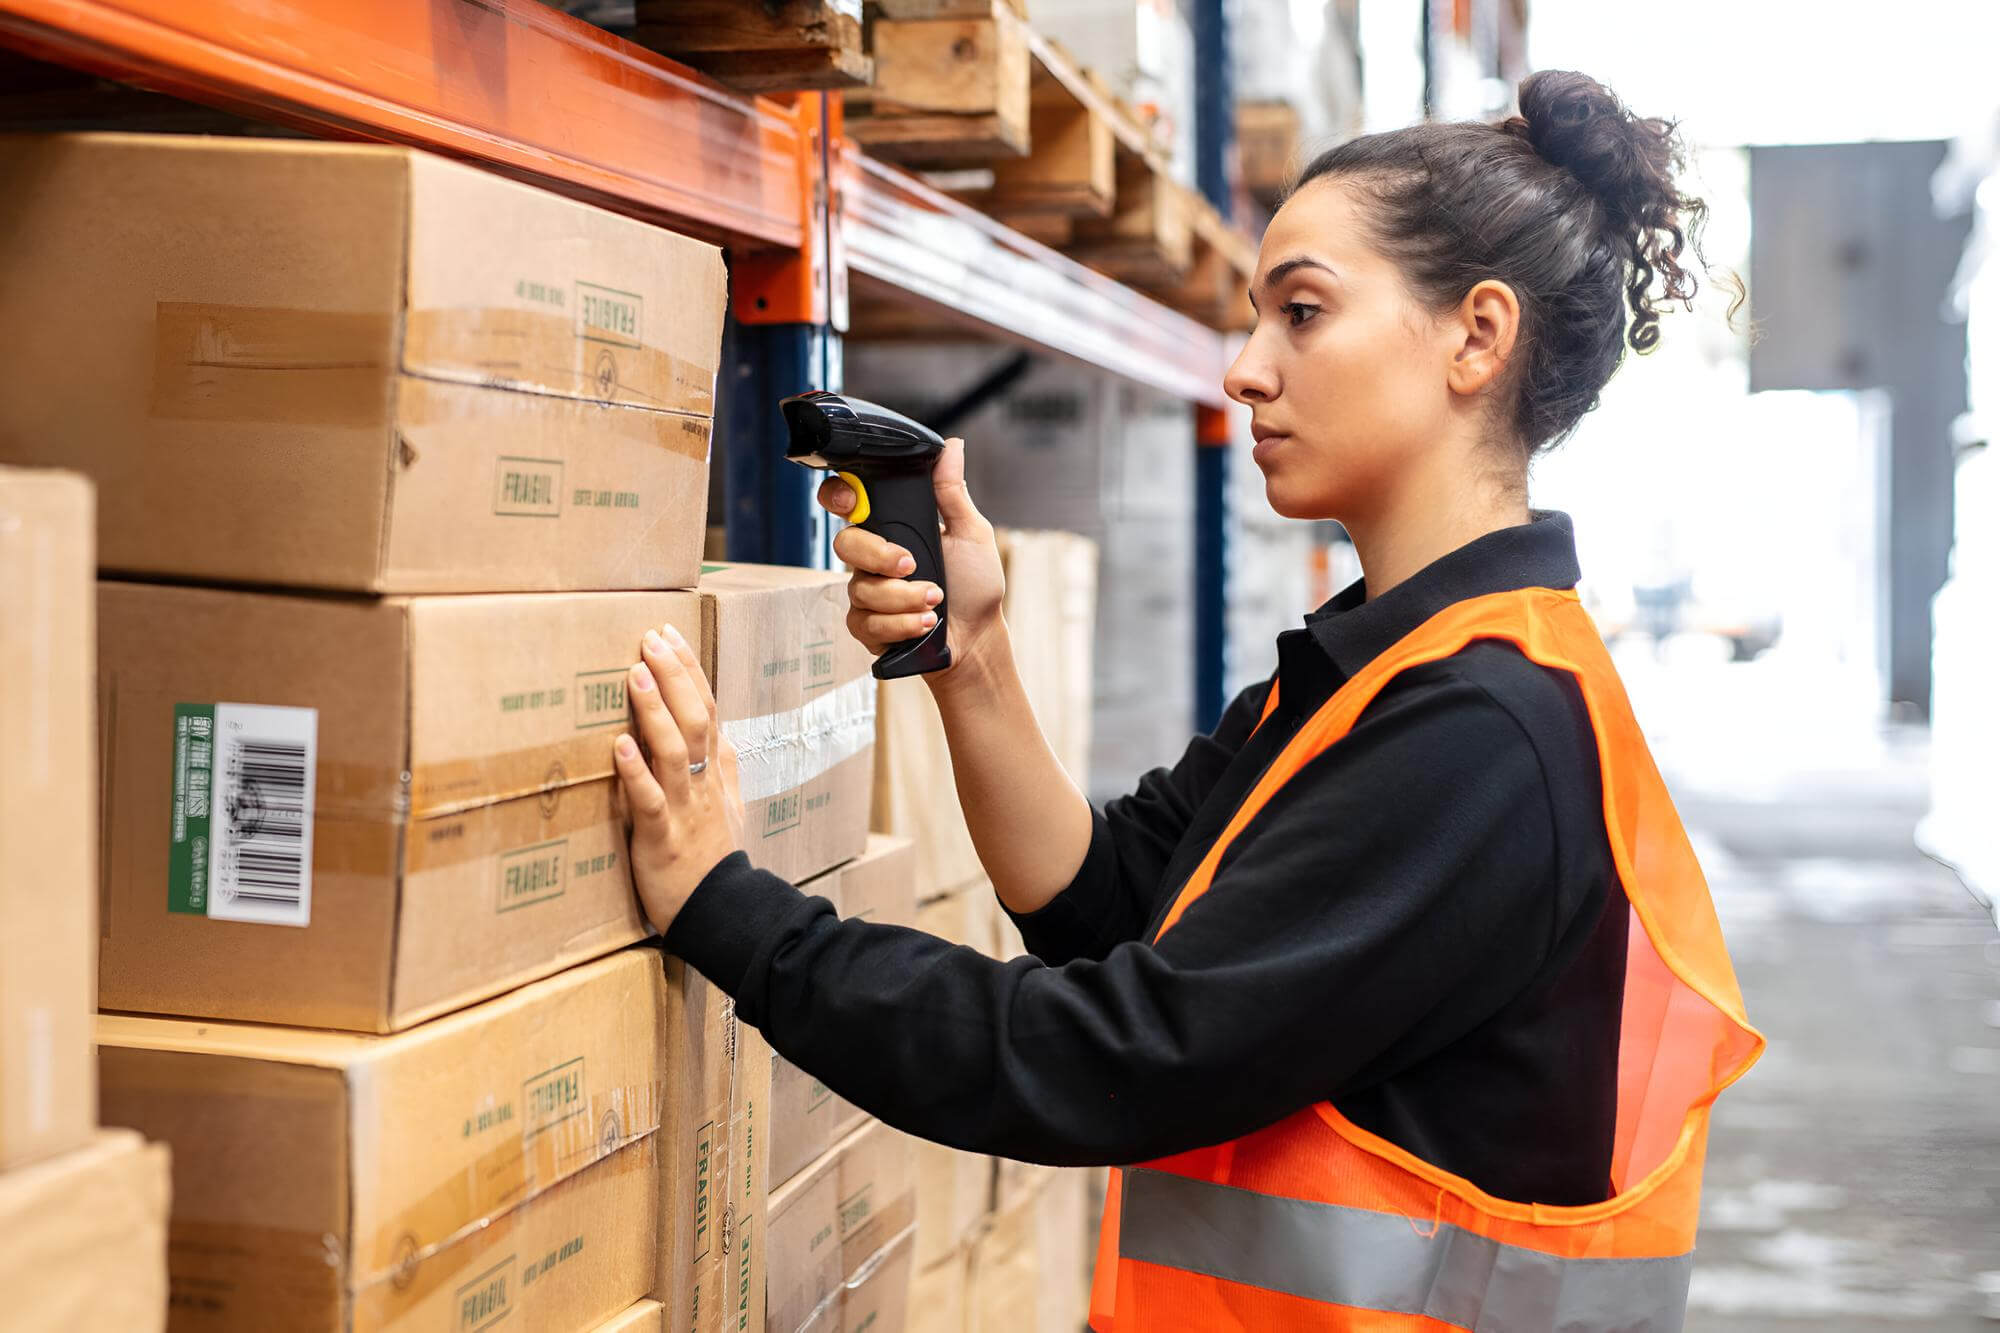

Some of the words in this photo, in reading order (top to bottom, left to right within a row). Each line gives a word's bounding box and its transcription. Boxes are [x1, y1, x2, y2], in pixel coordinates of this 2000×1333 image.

[583, 295, 636, 336] FRAGILE
[504, 856, 560, 899] FRAGILE
[697, 1140, 709, 1242] FRAGIL
[739, 1234, 751, 1332] RAGILE
